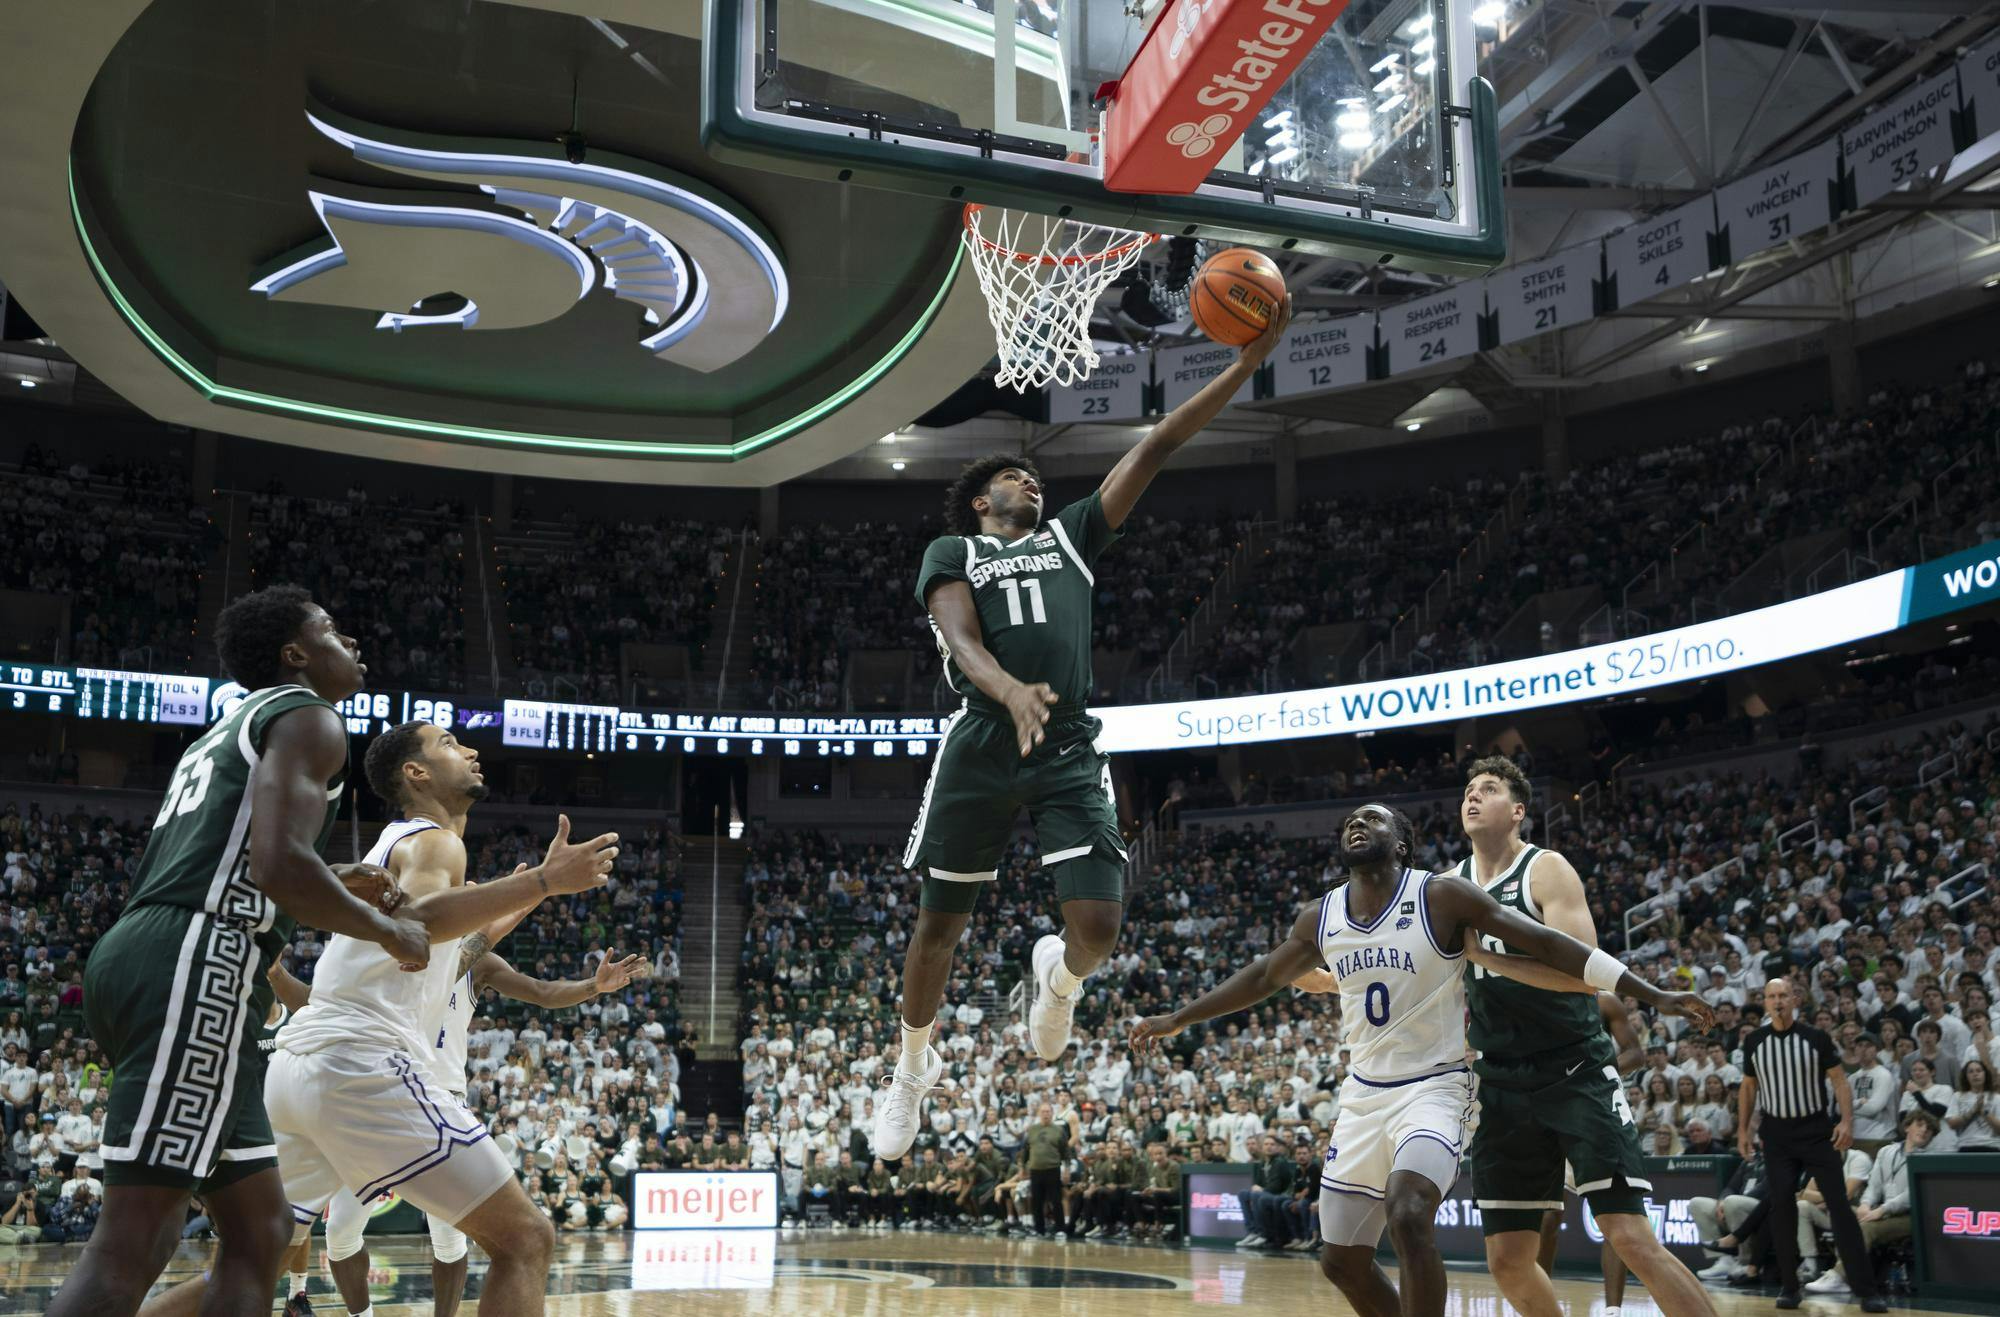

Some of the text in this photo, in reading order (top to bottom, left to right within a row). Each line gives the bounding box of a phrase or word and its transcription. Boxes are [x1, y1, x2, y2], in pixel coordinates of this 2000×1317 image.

[1845, 117, 1898, 157] EARVIN
[1868, 112, 1939, 164] JOHNSON
[1890, 149, 1921, 184] 33
[1761, 171, 1790, 195] JAY
[1745, 181, 1811, 219] VINCENT
[1637, 217, 1681, 248] SCOTT
[1768, 213, 1791, 241] 31
[1638, 236, 1684, 265] SKILES
[1520, 265, 1566, 289] STEVE
[1654, 264, 1669, 286] 4
[1227, 283, 1272, 317] ELITE
[1522, 282, 1567, 305] SMITH
[1406, 299, 1457, 323] SHAWN
[1534, 305, 1558, 329] 21
[1290, 326, 1347, 350] MATEEN
[1404, 312, 1462, 340] RESPERT
[1183, 348, 1233, 366] MORRIS
[1288, 340, 1355, 364] CLEAVES
[1419, 337, 1447, 363] 24
[1073, 379, 1120, 392] GREEN
[1309, 364, 1332, 386] 12
[1081, 397, 1110, 416] 23
[970, 552, 1063, 589] SPARTANS
[1943, 558, 2000, 598] WO
[998, 578, 1048, 626] 11
[11, 667, 74, 688] TO STL
[164, 682, 200, 695] TOL 4
[1176, 632, 1744, 745] Super-fast WOW! Internet $25/mo.
[13, 691, 62, 711] 3 2
[162, 702, 198, 716] FLS 3
[413, 699, 454, 729] 26
[619, 712, 646, 728] STL
[651, 712, 670, 729] TO
[676, 714, 704, 731] BLK
[708, 716, 739, 732] AST
[807, 718, 867, 734] FTM-FTA
[870, 719, 896, 734] FT%
[519, 727, 542, 739] FLS
[626, 735, 638, 750] 3
[655, 735, 666, 751] 7
[751, 739, 763, 754] 2
[784, 740, 800, 755] 10
[152, 730, 230, 831] 55
[1335, 946, 1418, 982] NIAGARA
[1364, 981, 1391, 1027] 0
[648, 1177, 764, 1223] meijer
